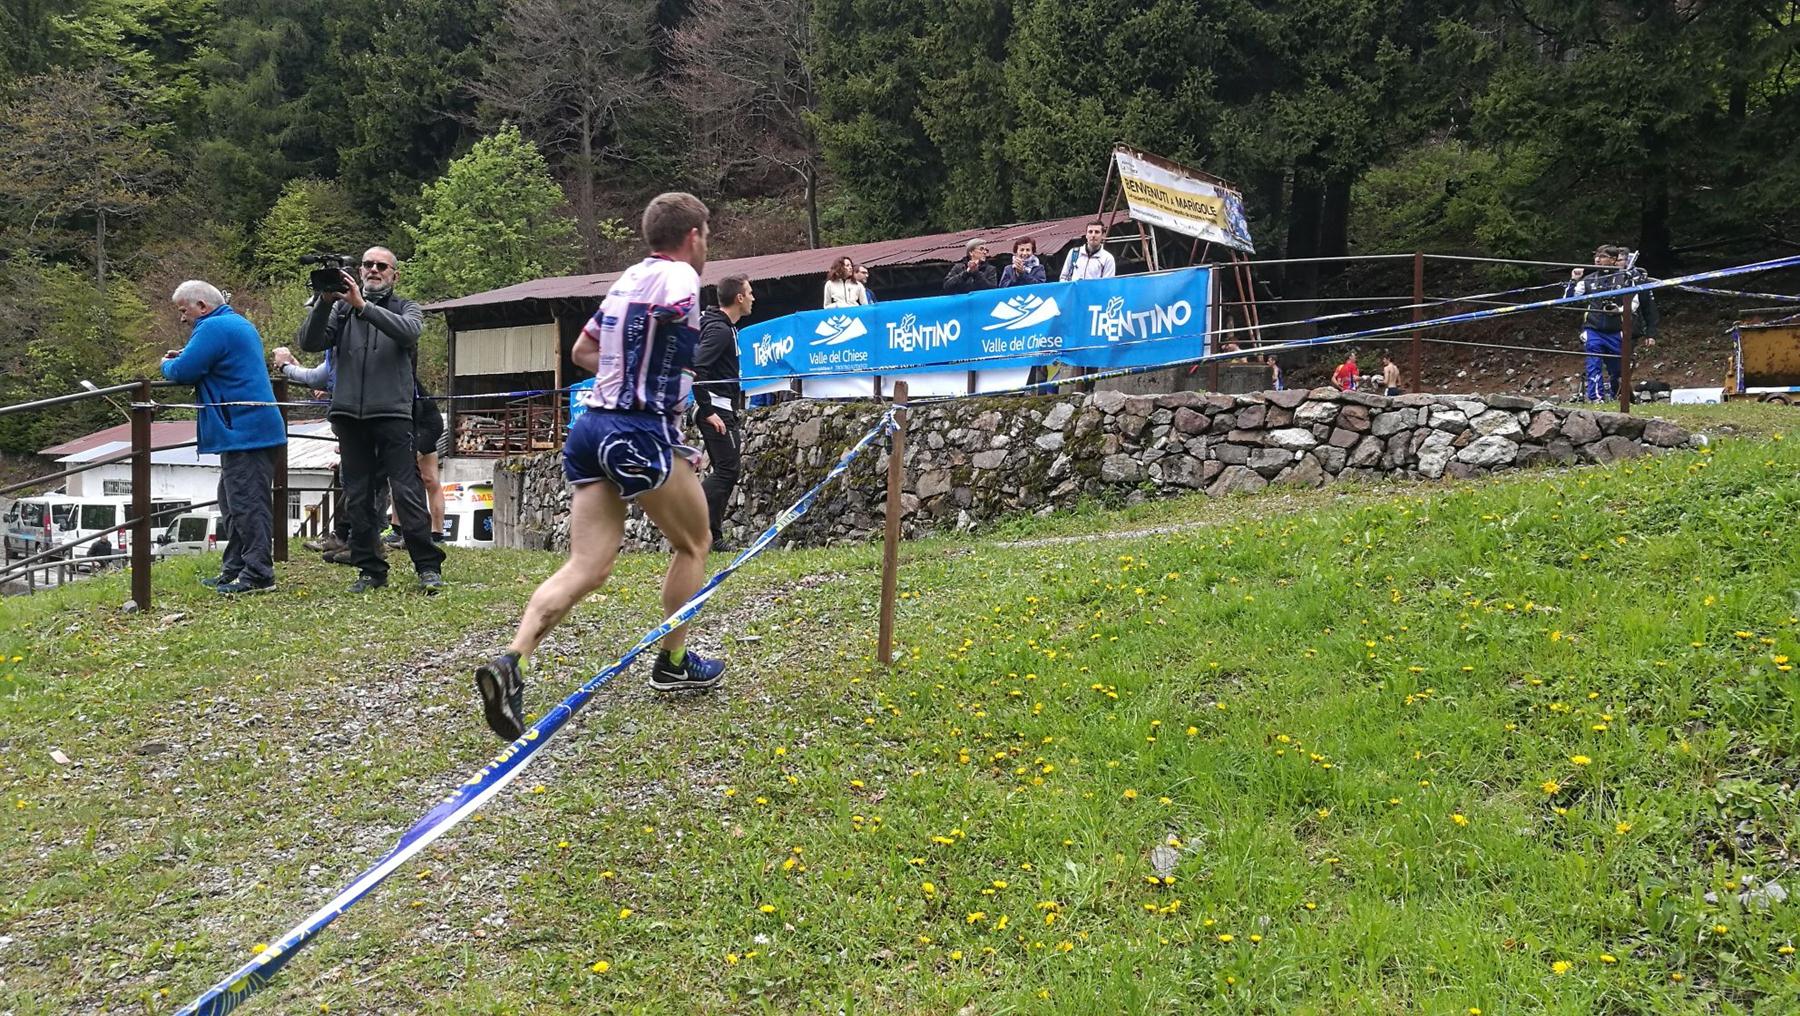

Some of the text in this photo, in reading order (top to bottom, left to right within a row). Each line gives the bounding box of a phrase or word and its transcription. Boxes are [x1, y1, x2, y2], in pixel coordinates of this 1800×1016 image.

[1124, 178, 1169, 204] BENVENUTI
[1088, 300, 1192, 341] TRENTINO
[886, 319, 961, 352] TRENTINO
[981, 333, 1063, 353] Valle del Chiese
[809, 349, 868, 365] Valle del Chiese
